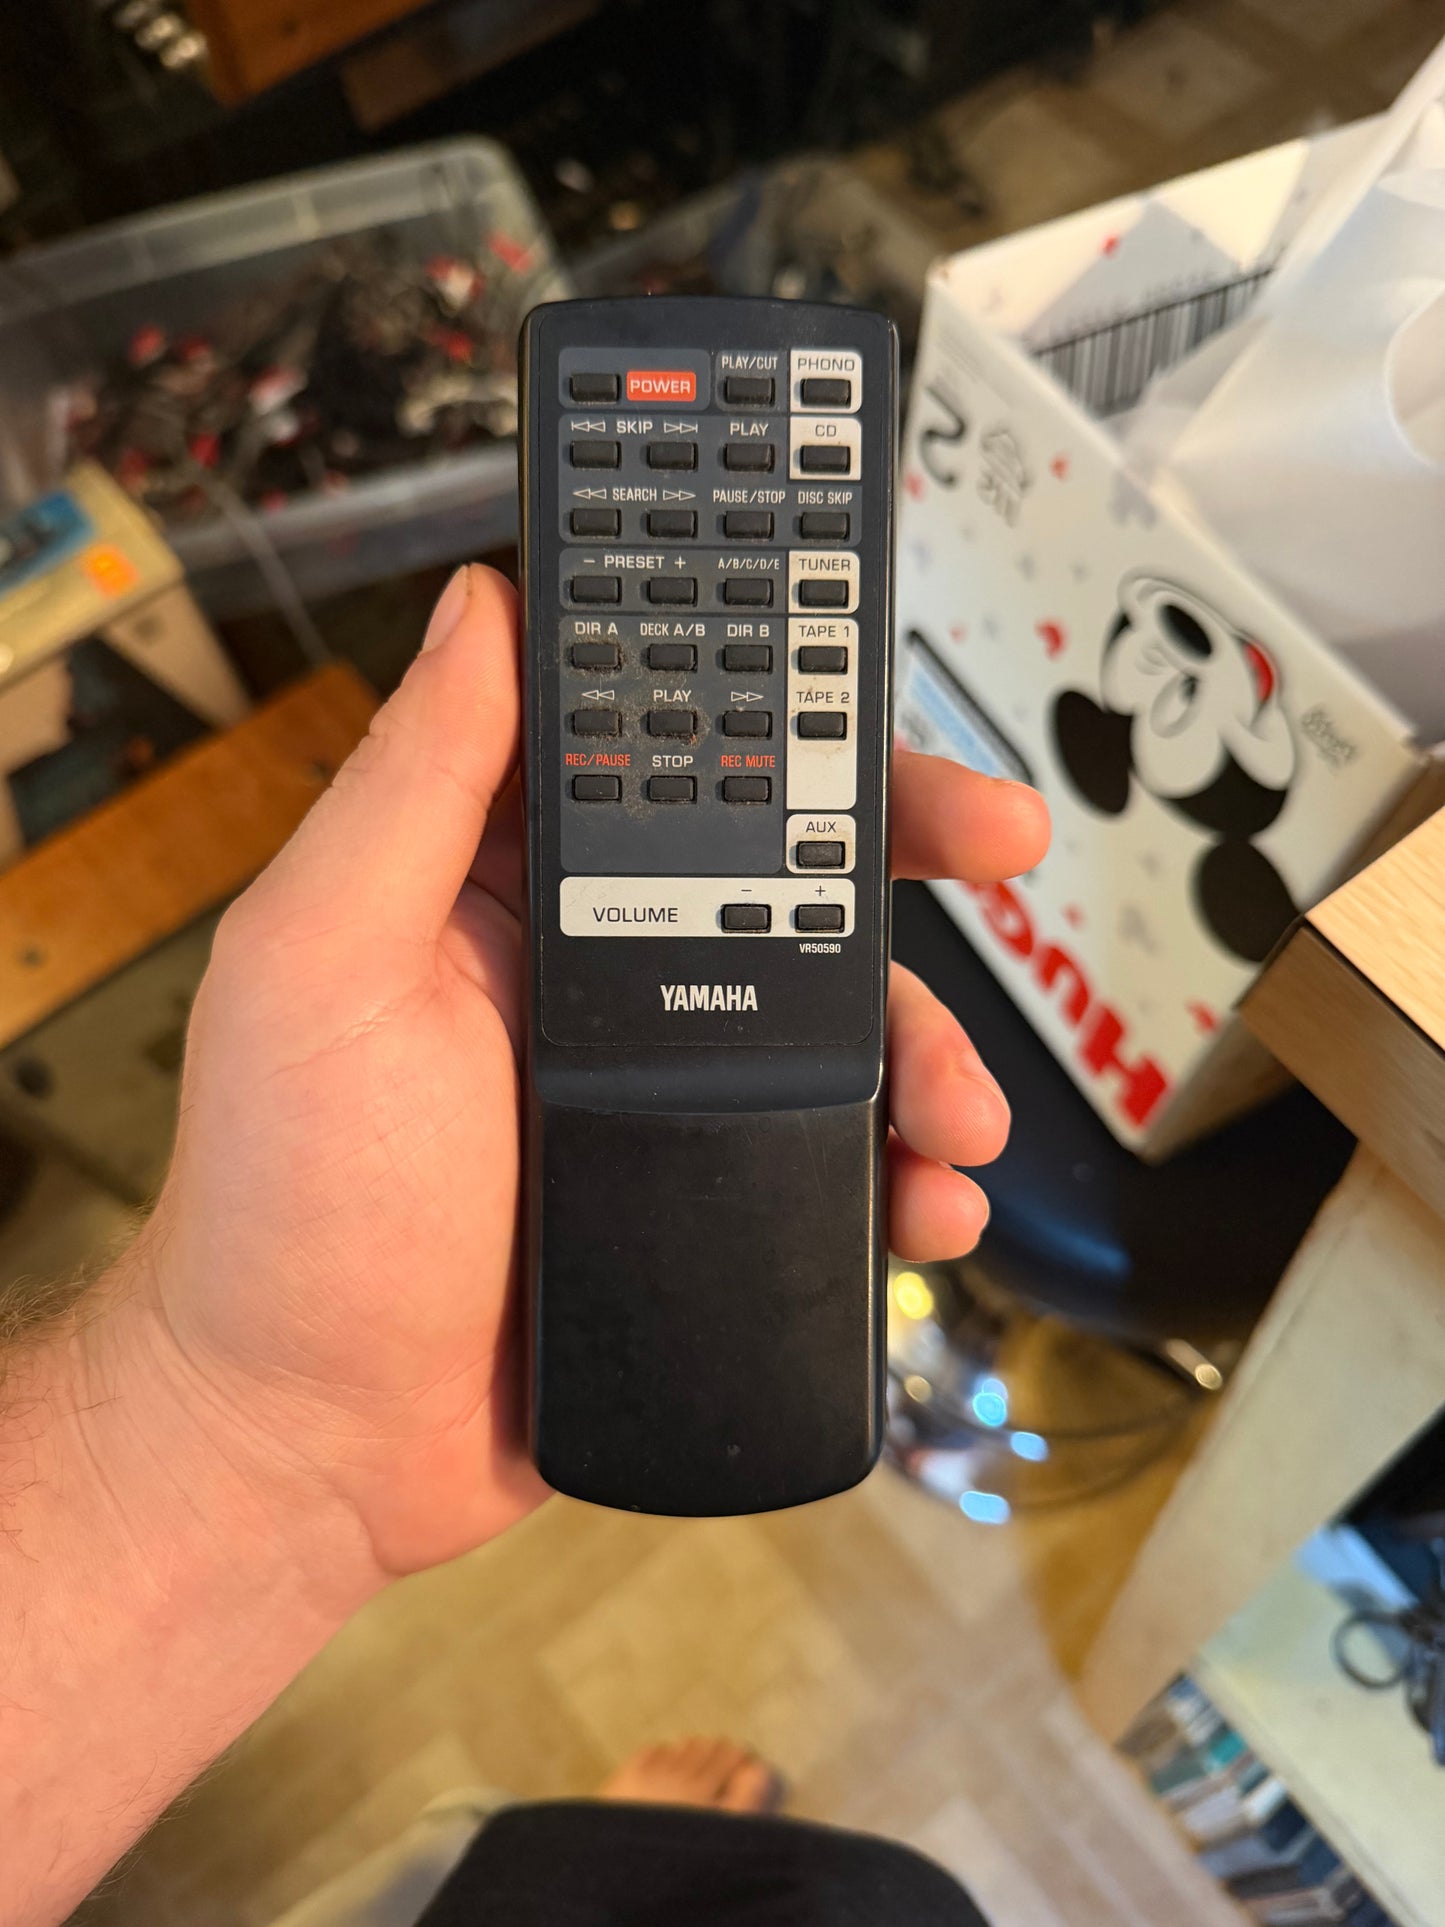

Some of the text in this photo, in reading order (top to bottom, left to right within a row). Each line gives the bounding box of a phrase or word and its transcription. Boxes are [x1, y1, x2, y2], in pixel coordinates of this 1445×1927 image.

[722, 356, 777, 370] PLAY/CUT
[798, 358, 854, 372] PHONO
[631, 379, 690, 394] POWER
[617, 421, 652, 434] SKIP
[730, 422, 768, 437] PLAY
[815, 425, 836, 438] CD
[613, 488, 657, 502] SEARCH
[713, 490, 785, 504] PAUSE/STOP
[798, 491, 852, 505] DISC SKIP
[605, 555, 664, 569] PRESET
[718, 558, 779, 570] A/B/C/D/E
[799, 559, 850, 572] TUNER
[575, 622, 618, 636] DIR A
[641, 623, 705, 637] DECK A/B
[728, 624, 769, 638] DIR B
[799, 626, 849, 638] TAPE 1
[654, 690, 691, 703] PLAY
[796, 691, 849, 704] TAPE 2
[565, 754, 629, 767] REC/PAUSE
[652, 755, 693, 768] STOP
[720, 755, 774, 769] REC MUTE
[806, 822, 836, 833] AUX
[593, 908, 677, 923] VOLUME
[799, 943, 841, 954] VR50590
[661, 985, 758, 1011] YAMAHA
